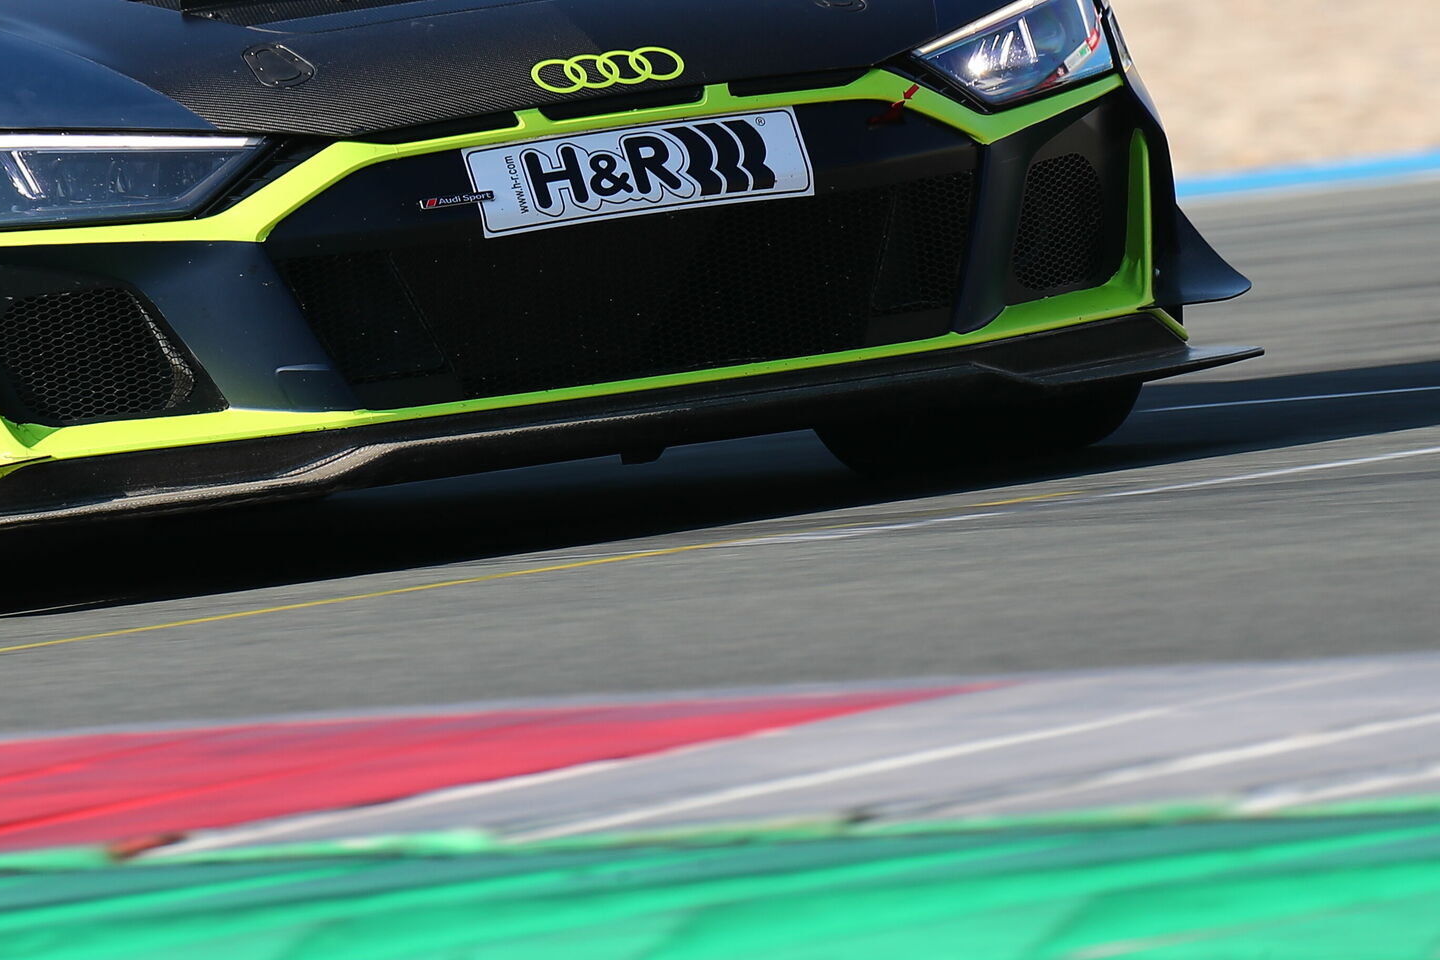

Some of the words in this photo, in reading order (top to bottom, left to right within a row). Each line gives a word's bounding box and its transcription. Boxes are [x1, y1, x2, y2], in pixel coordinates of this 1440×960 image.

[438, 195, 461, 205] Audi
[462, 191, 492, 202] Sport
[504, 155, 529, 214] www.h-r.com
[523, 135, 683, 210] H&R
